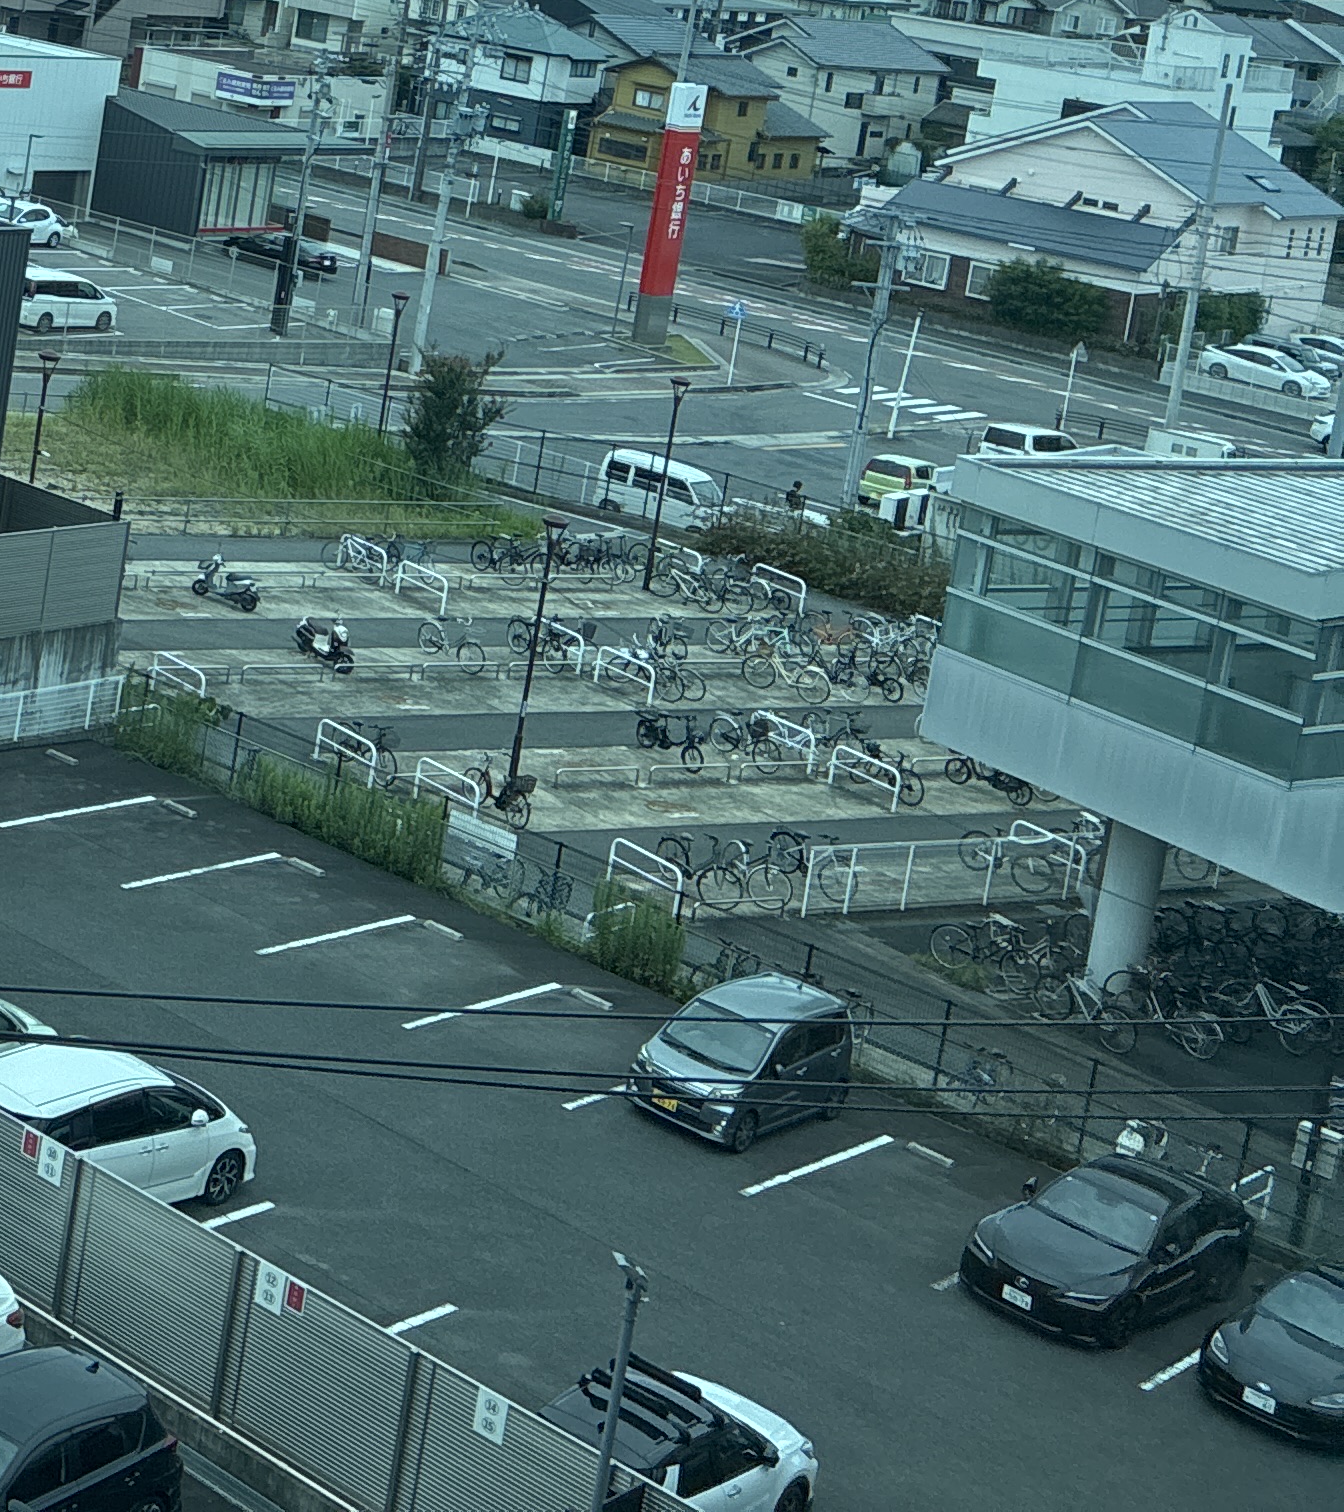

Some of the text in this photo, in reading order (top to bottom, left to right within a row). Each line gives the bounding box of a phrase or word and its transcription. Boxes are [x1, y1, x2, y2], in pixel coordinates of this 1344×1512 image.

[667, 147, 693, 239] あいち銀行
